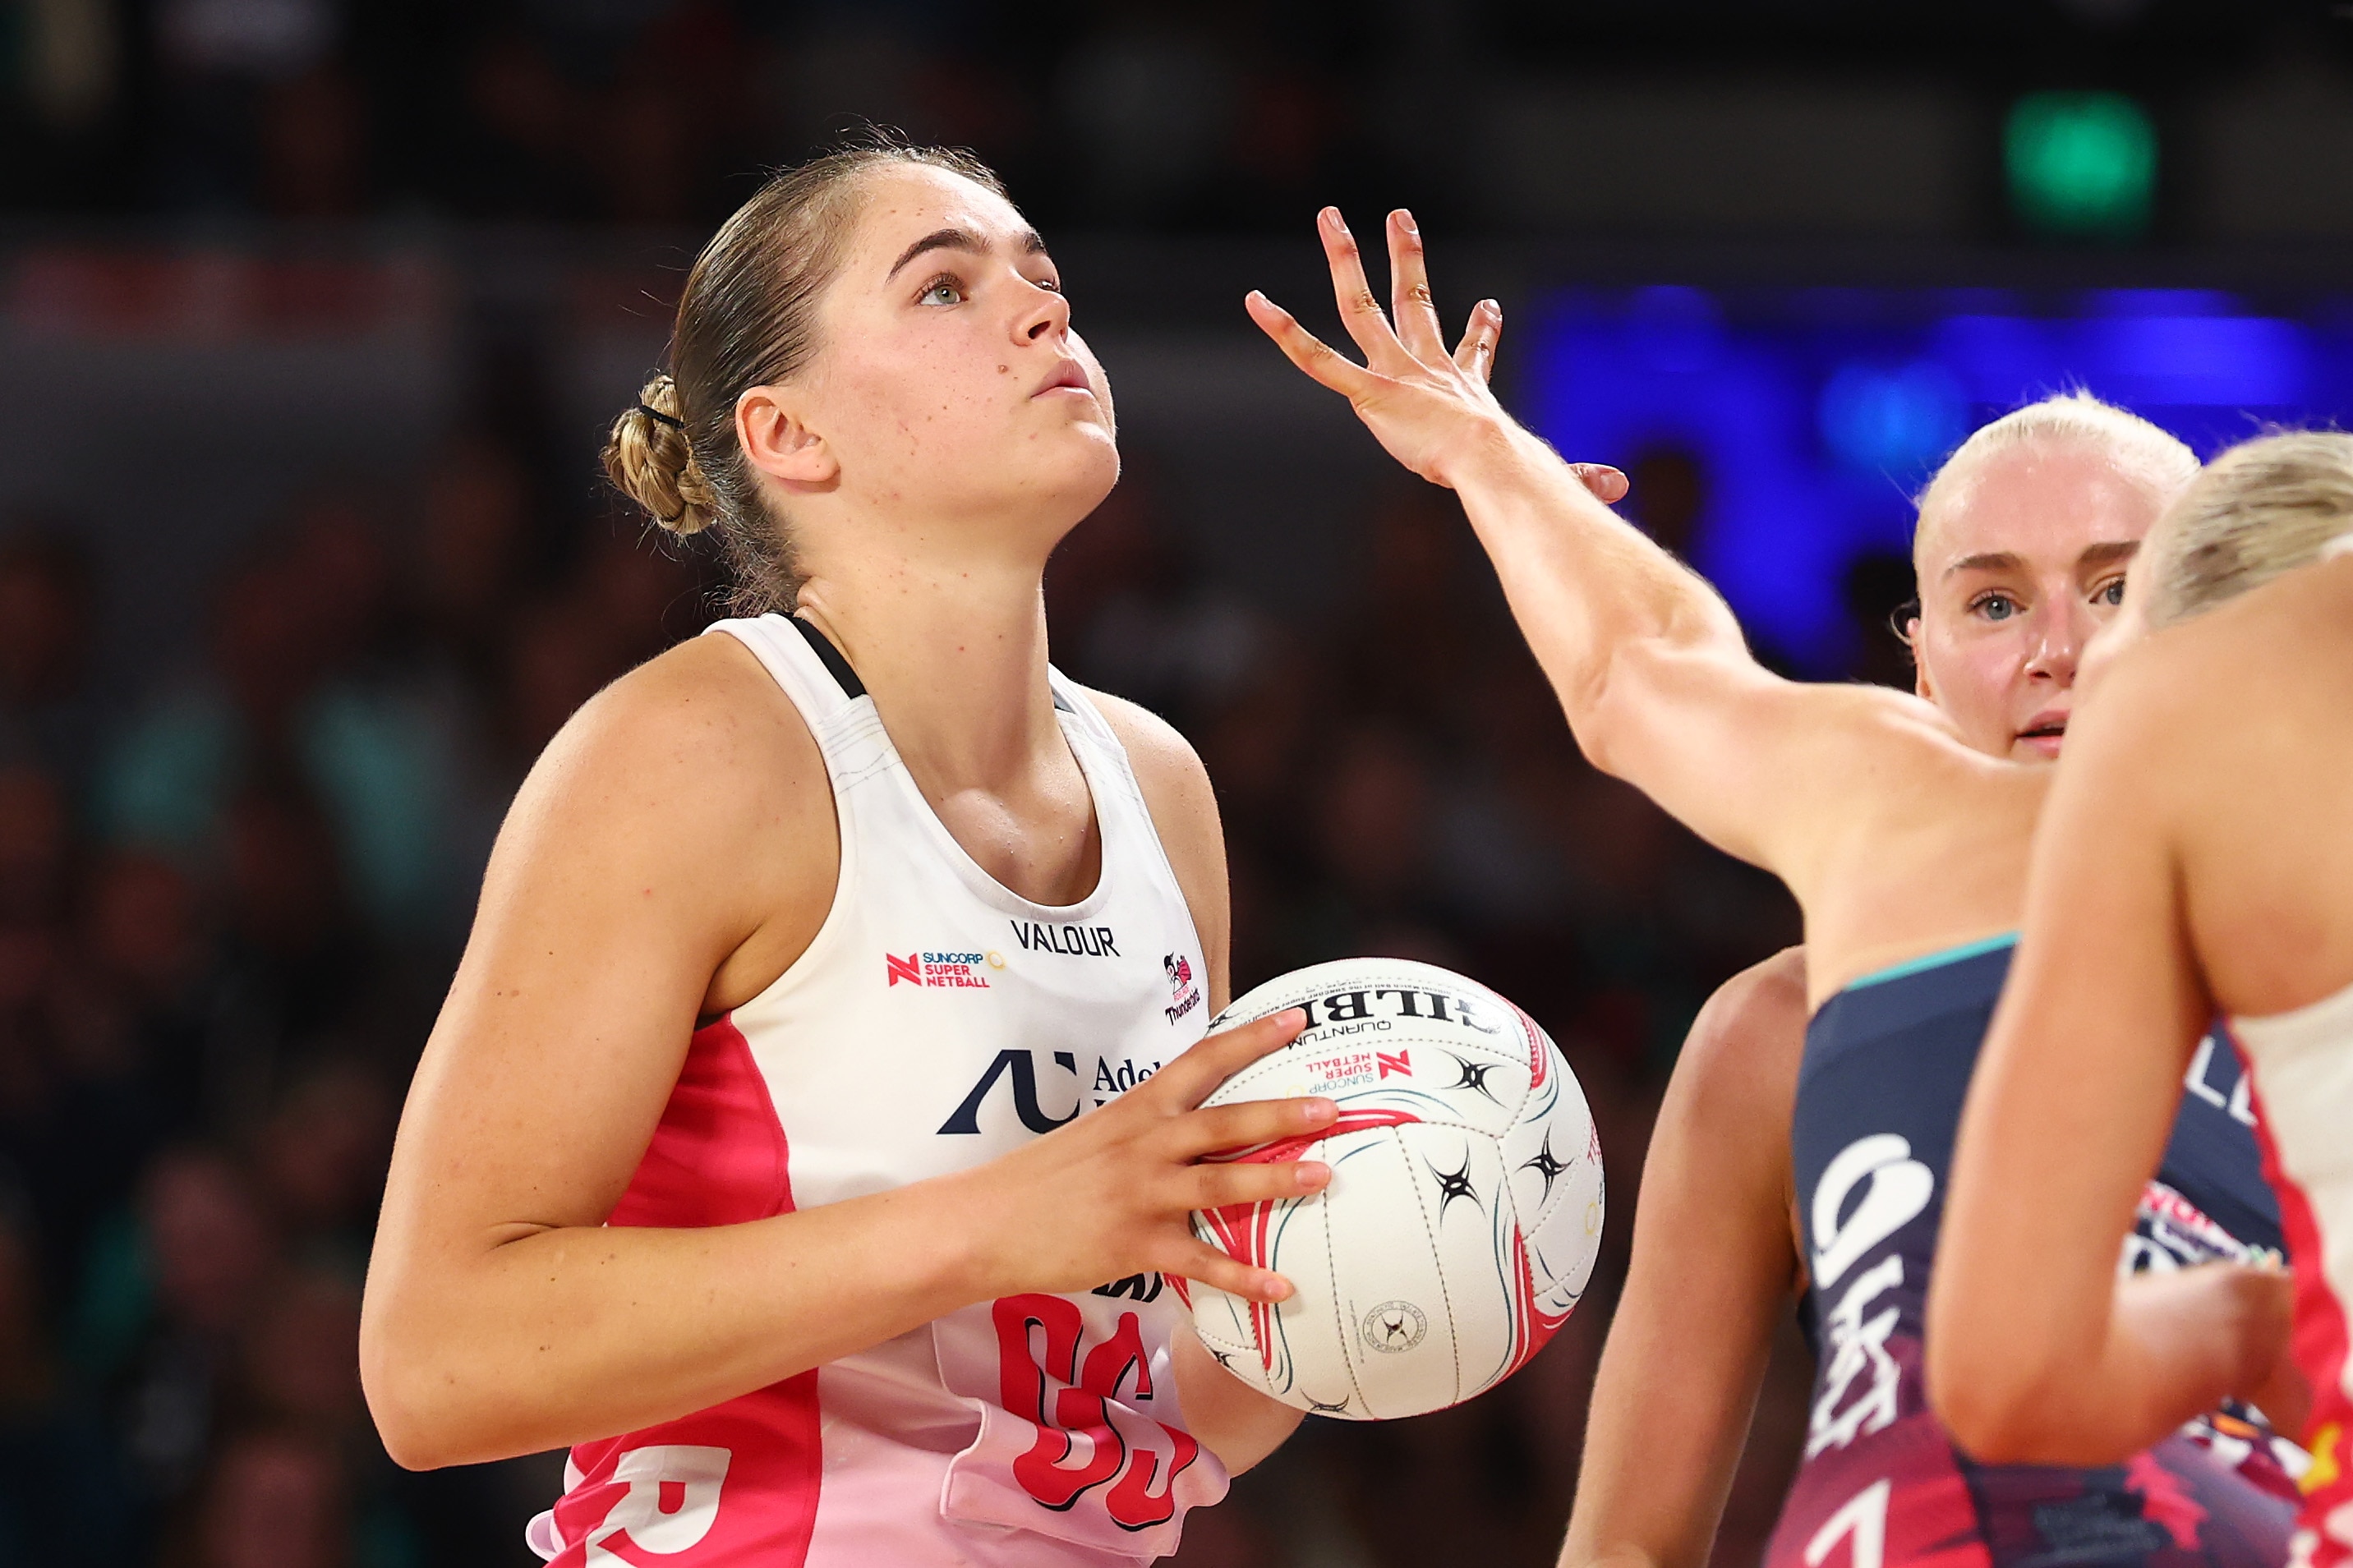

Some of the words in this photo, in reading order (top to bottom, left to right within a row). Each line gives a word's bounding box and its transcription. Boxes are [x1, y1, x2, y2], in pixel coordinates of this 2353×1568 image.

[1011, 920, 1121, 957] VALOUR
[923, 952, 983, 964] SUNCORP
[925, 964, 970, 976] SUPER
[926, 976, 990, 988] NETBALL
[1287, 1020, 1391, 1050] QUANTUM
[1306, 1052, 1371, 1073] NETBALL
[1325, 1064, 1373, 1079] SUPER
[1093, 1055, 1161, 1092] Ade
[1309, 1073, 1375, 1094] SUNCORP
